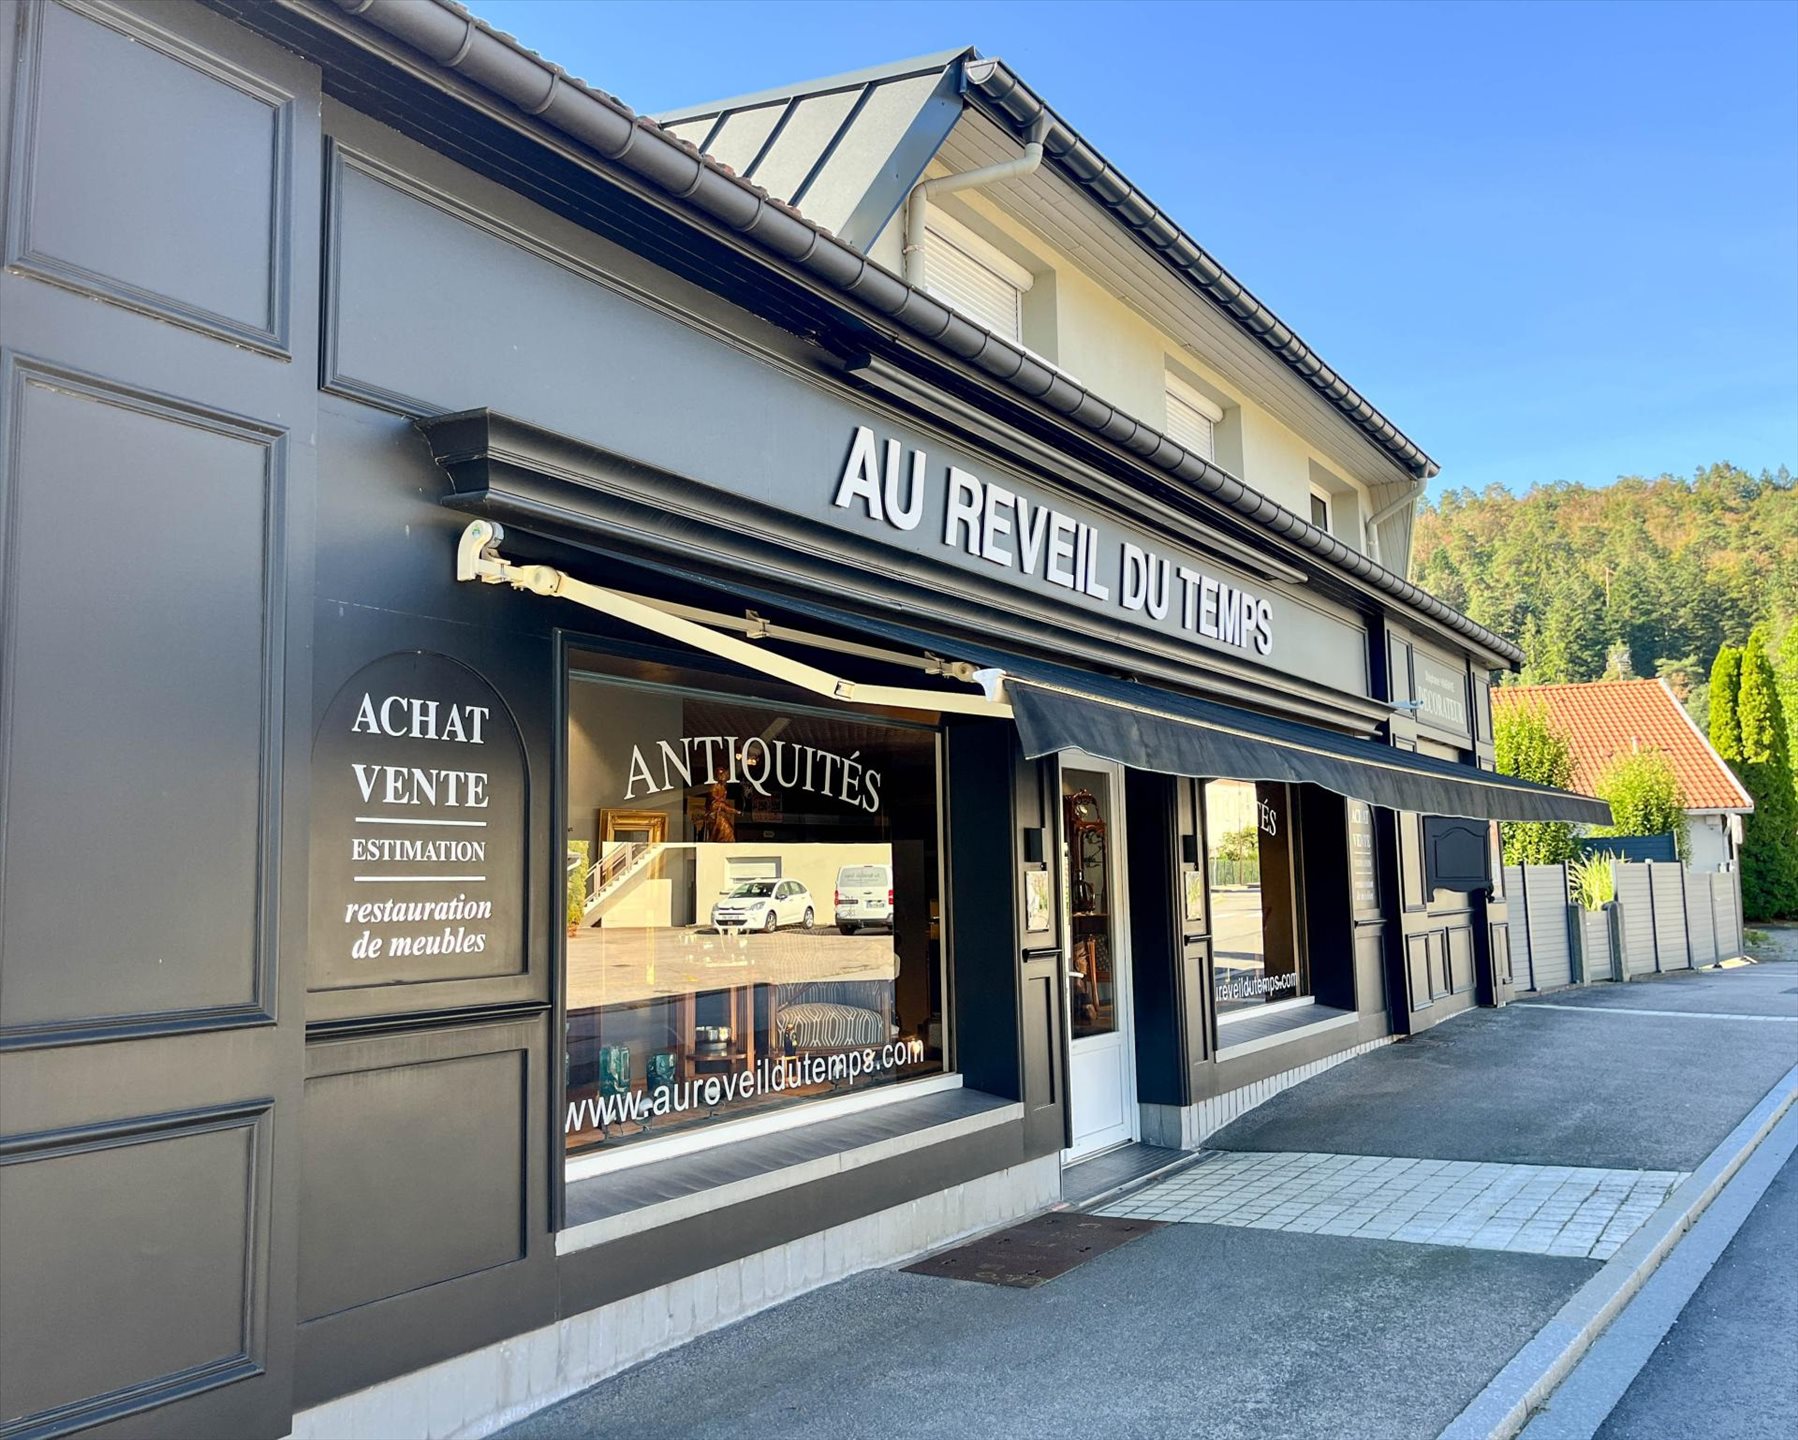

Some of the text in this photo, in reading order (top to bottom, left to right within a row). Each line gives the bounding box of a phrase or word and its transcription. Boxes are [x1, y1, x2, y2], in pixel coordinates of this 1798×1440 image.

[836, 426, 1273, 656] AU REVEIL DU TEMPS
[352, 692, 489, 744] ACHAT
[352, 763, 489, 808] VENTE
[624, 736, 881, 813] ANTIQUITÉS
[352, 838, 486, 862] ESTIMATION
[345, 894, 492, 923] restauration
[352, 927, 486, 959] de meubles
